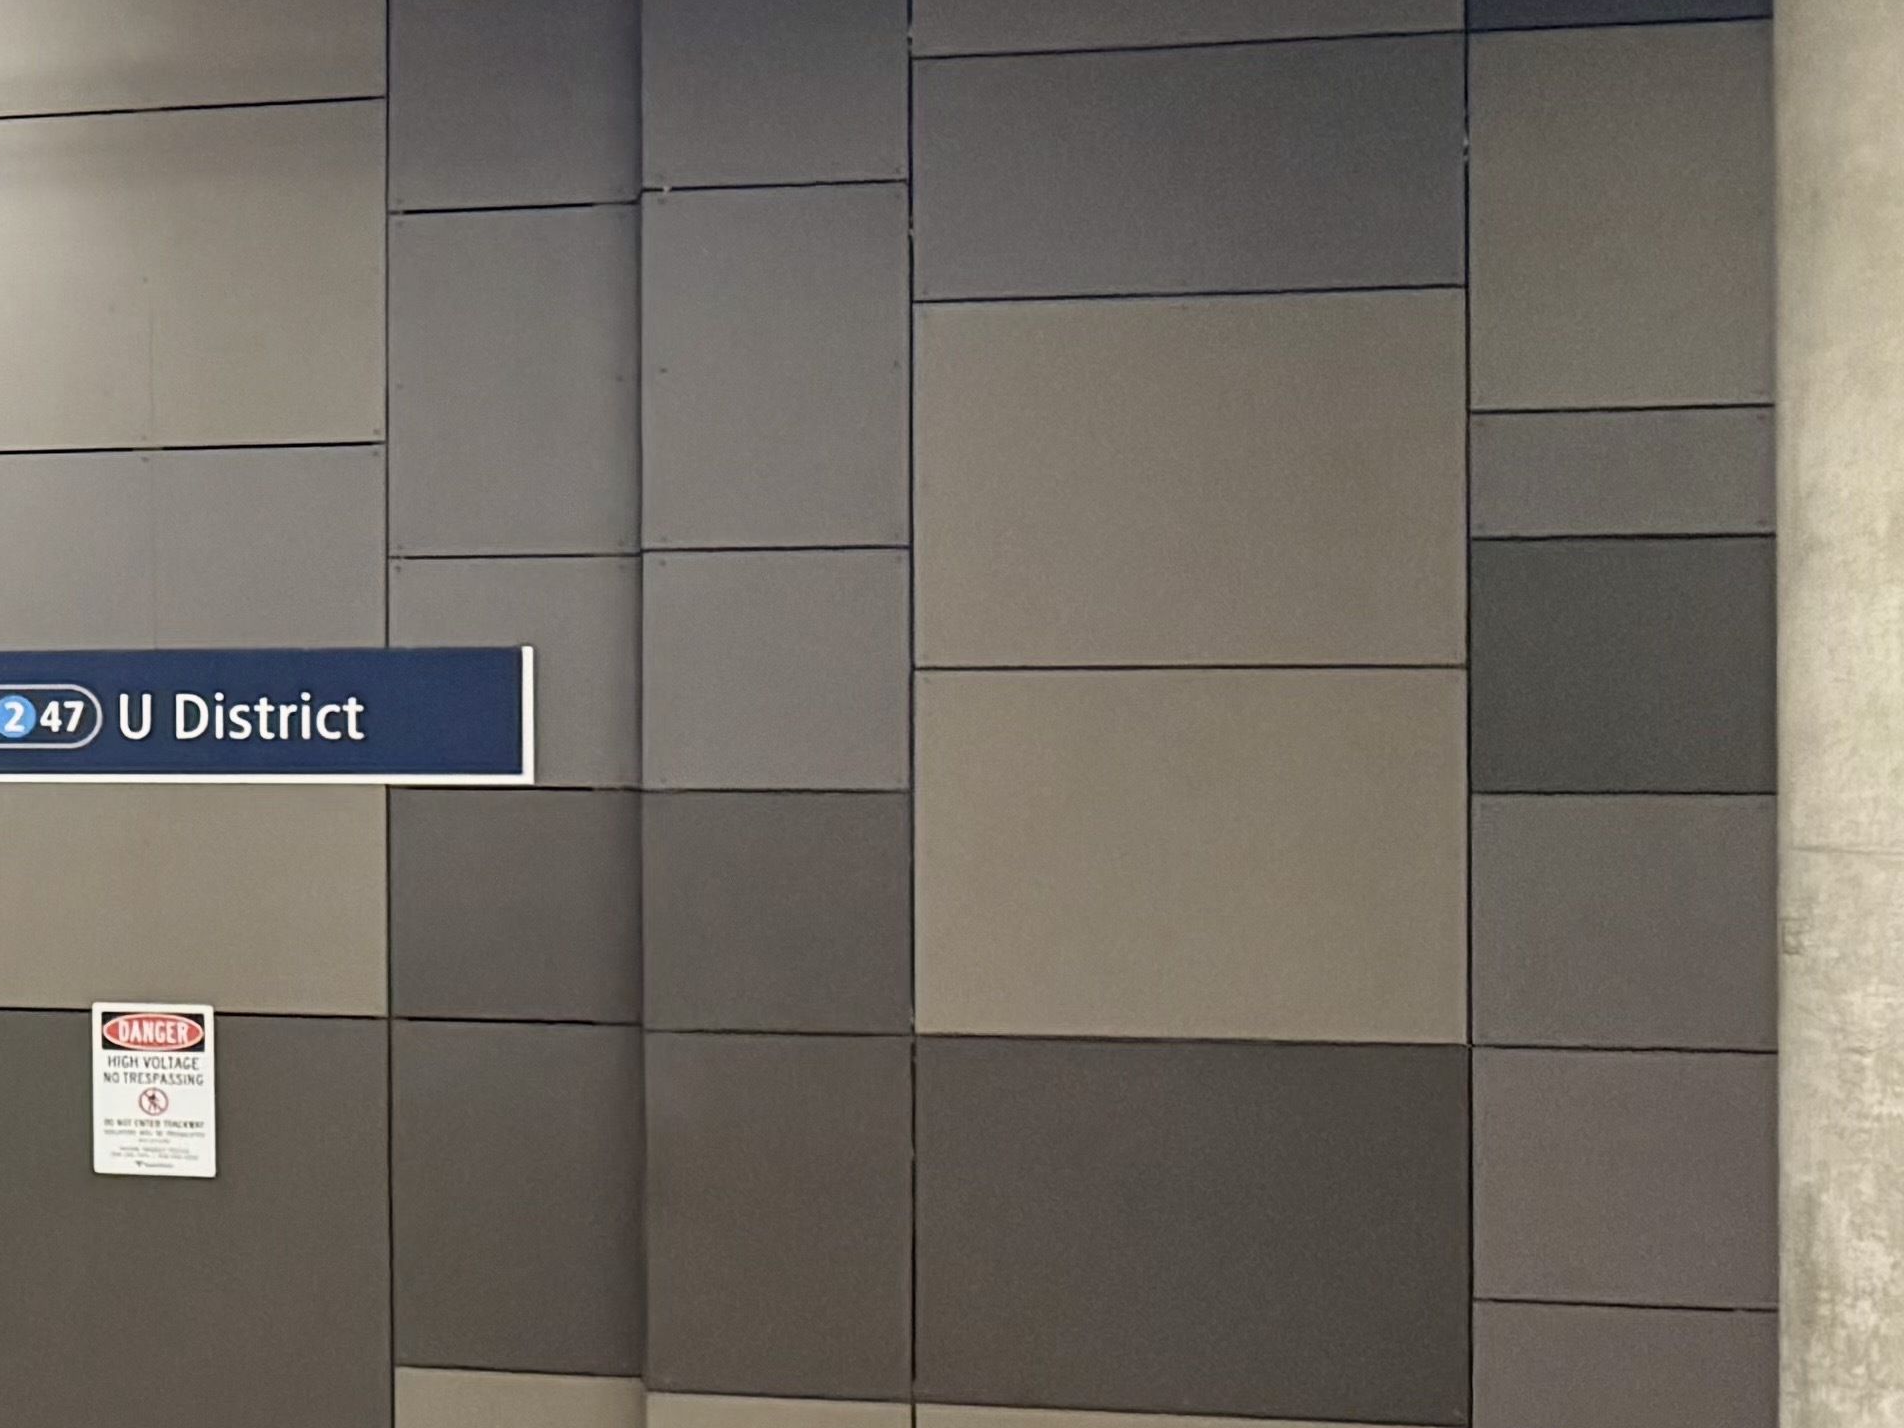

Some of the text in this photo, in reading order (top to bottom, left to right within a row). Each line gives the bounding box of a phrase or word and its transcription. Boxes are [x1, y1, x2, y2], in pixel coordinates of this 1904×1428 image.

[3, 701, 26, 733] 2
[39, 700, 85, 733] 47
[119, 693, 152, 740] U
[175, 691, 365, 740] District
[118, 1019, 189, 1045] DANGER
[107, 1055, 200, 1070] HIGH VOLTAGE
[104, 1072, 204, 1087] NO TRESPASSING
